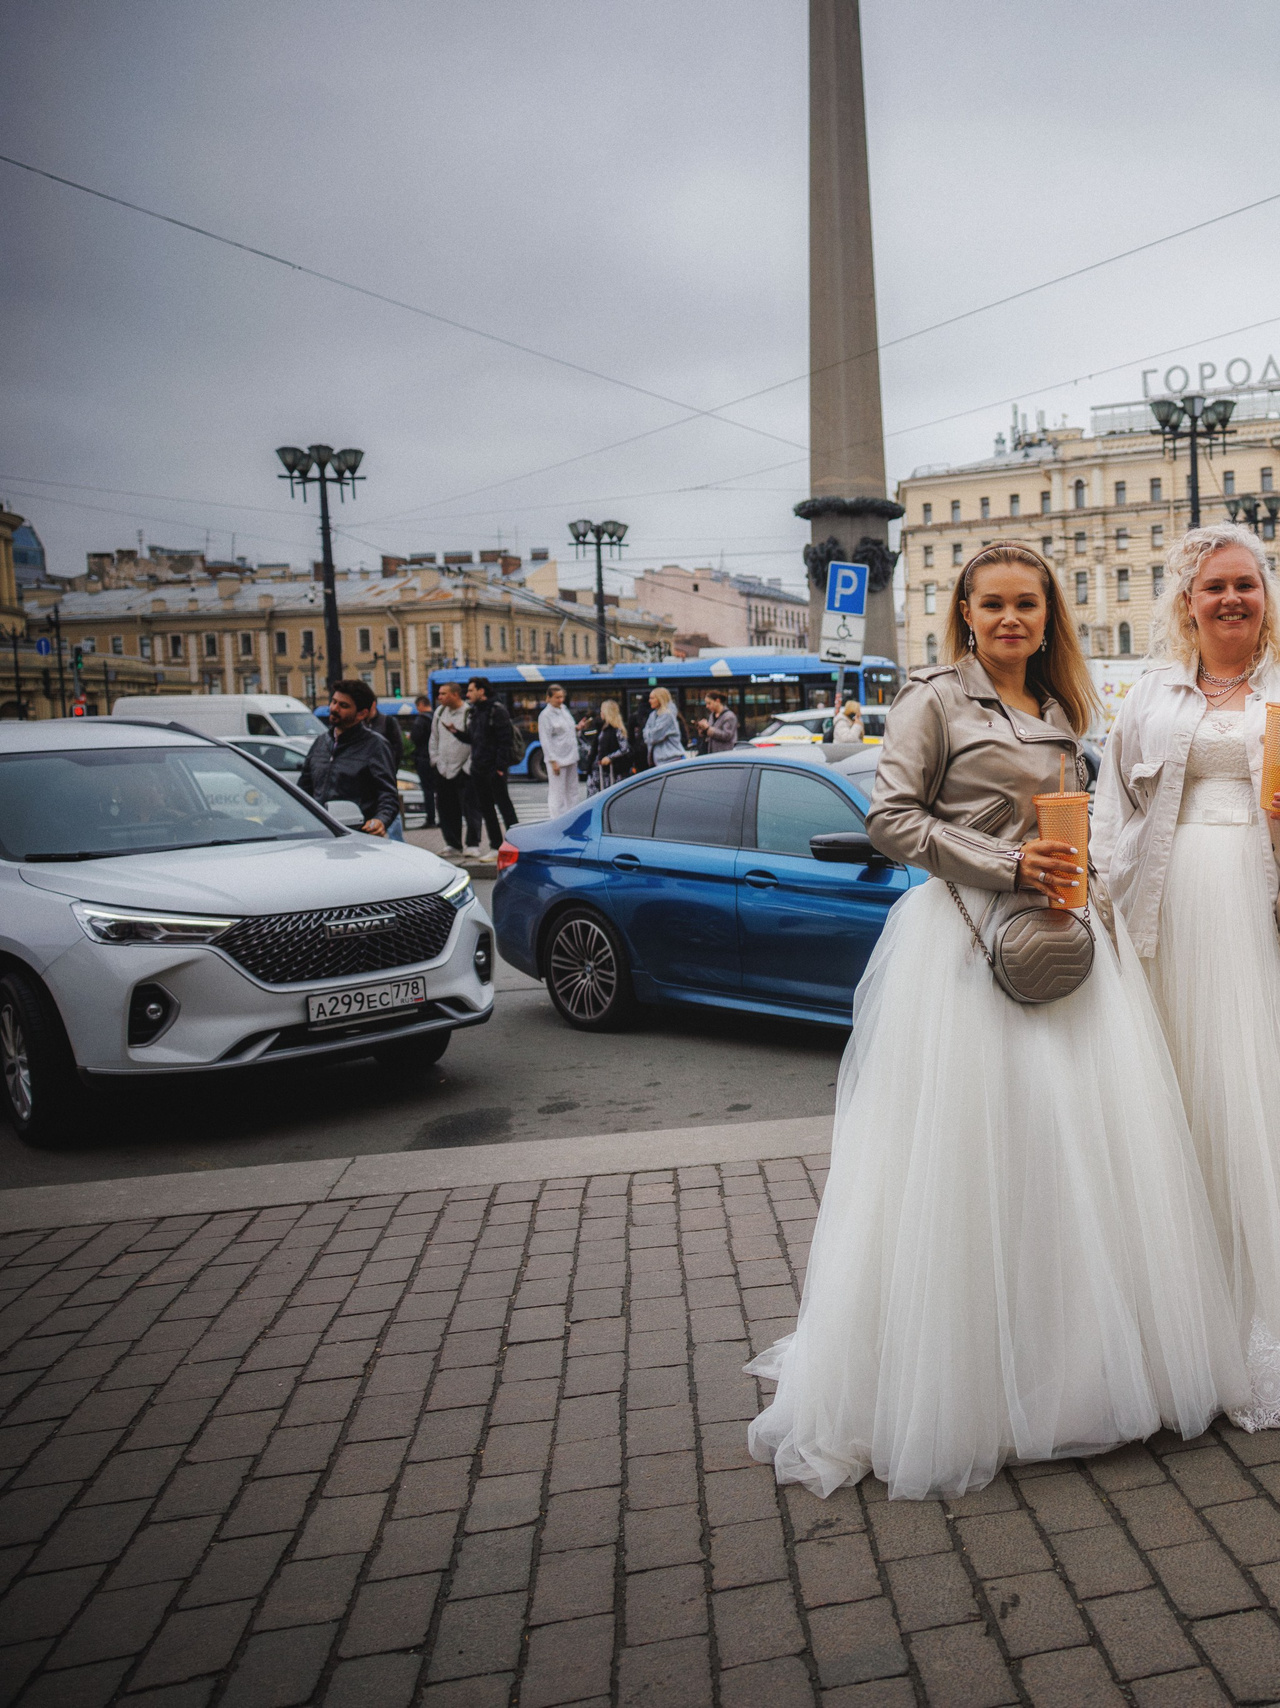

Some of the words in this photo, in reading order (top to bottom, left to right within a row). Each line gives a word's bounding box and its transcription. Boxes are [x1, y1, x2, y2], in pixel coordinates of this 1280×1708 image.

[834, 568, 858, 608] P
[330, 918, 395, 936] HAVAL
[316, 991, 390, 1019] А299ЕС
[393, 981, 420, 999] 778
